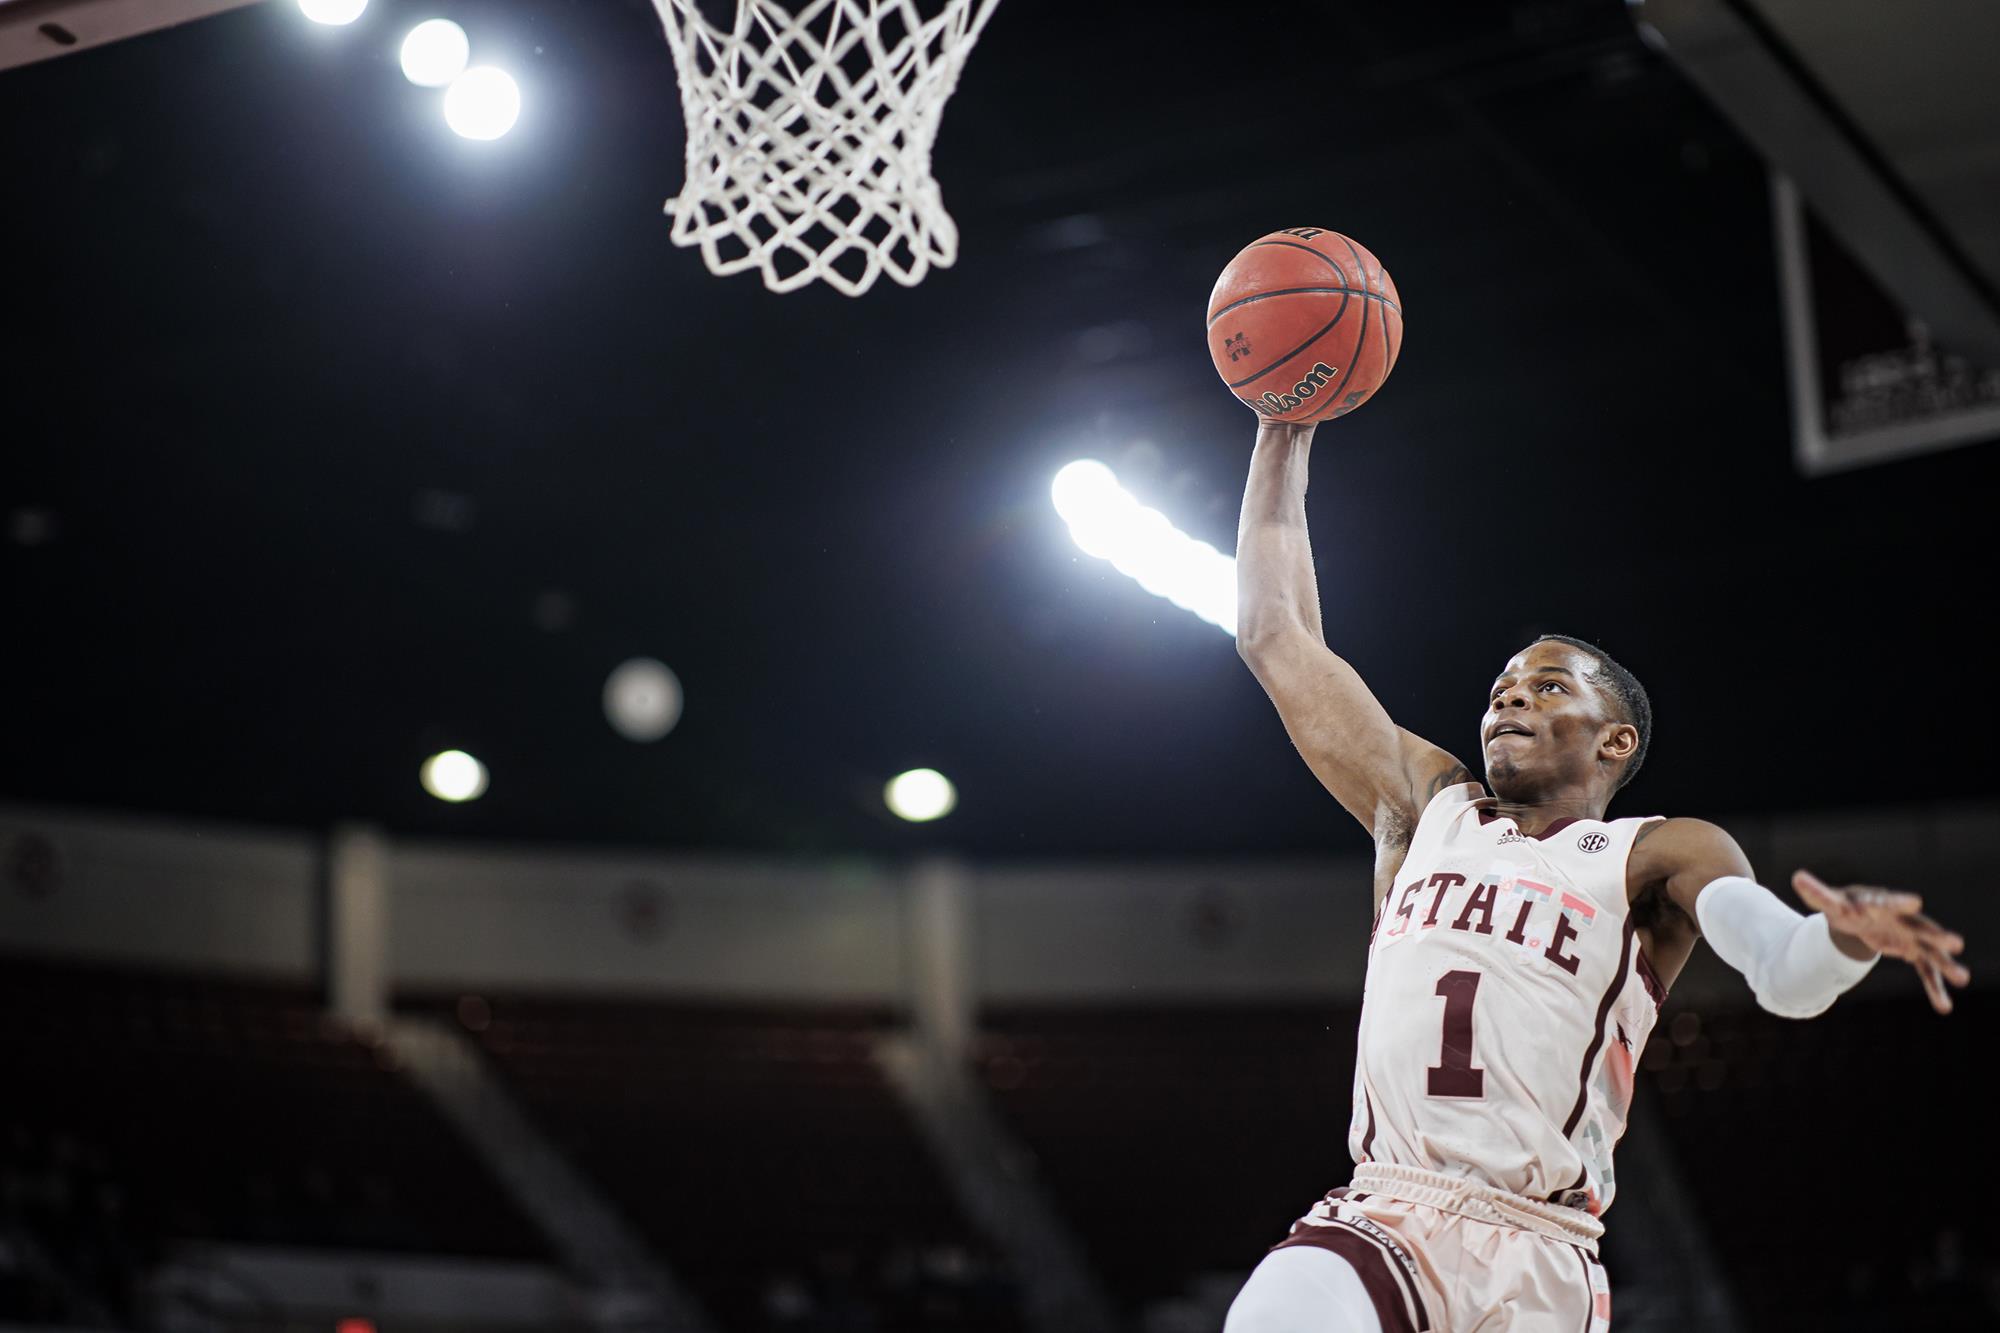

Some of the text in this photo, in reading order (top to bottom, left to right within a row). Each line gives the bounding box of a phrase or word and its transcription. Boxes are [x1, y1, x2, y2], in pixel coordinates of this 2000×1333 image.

[1580, 834, 1607, 852] SEC
[1386, 872, 1597, 977] STATE
[1426, 969, 1486, 1099] 1
